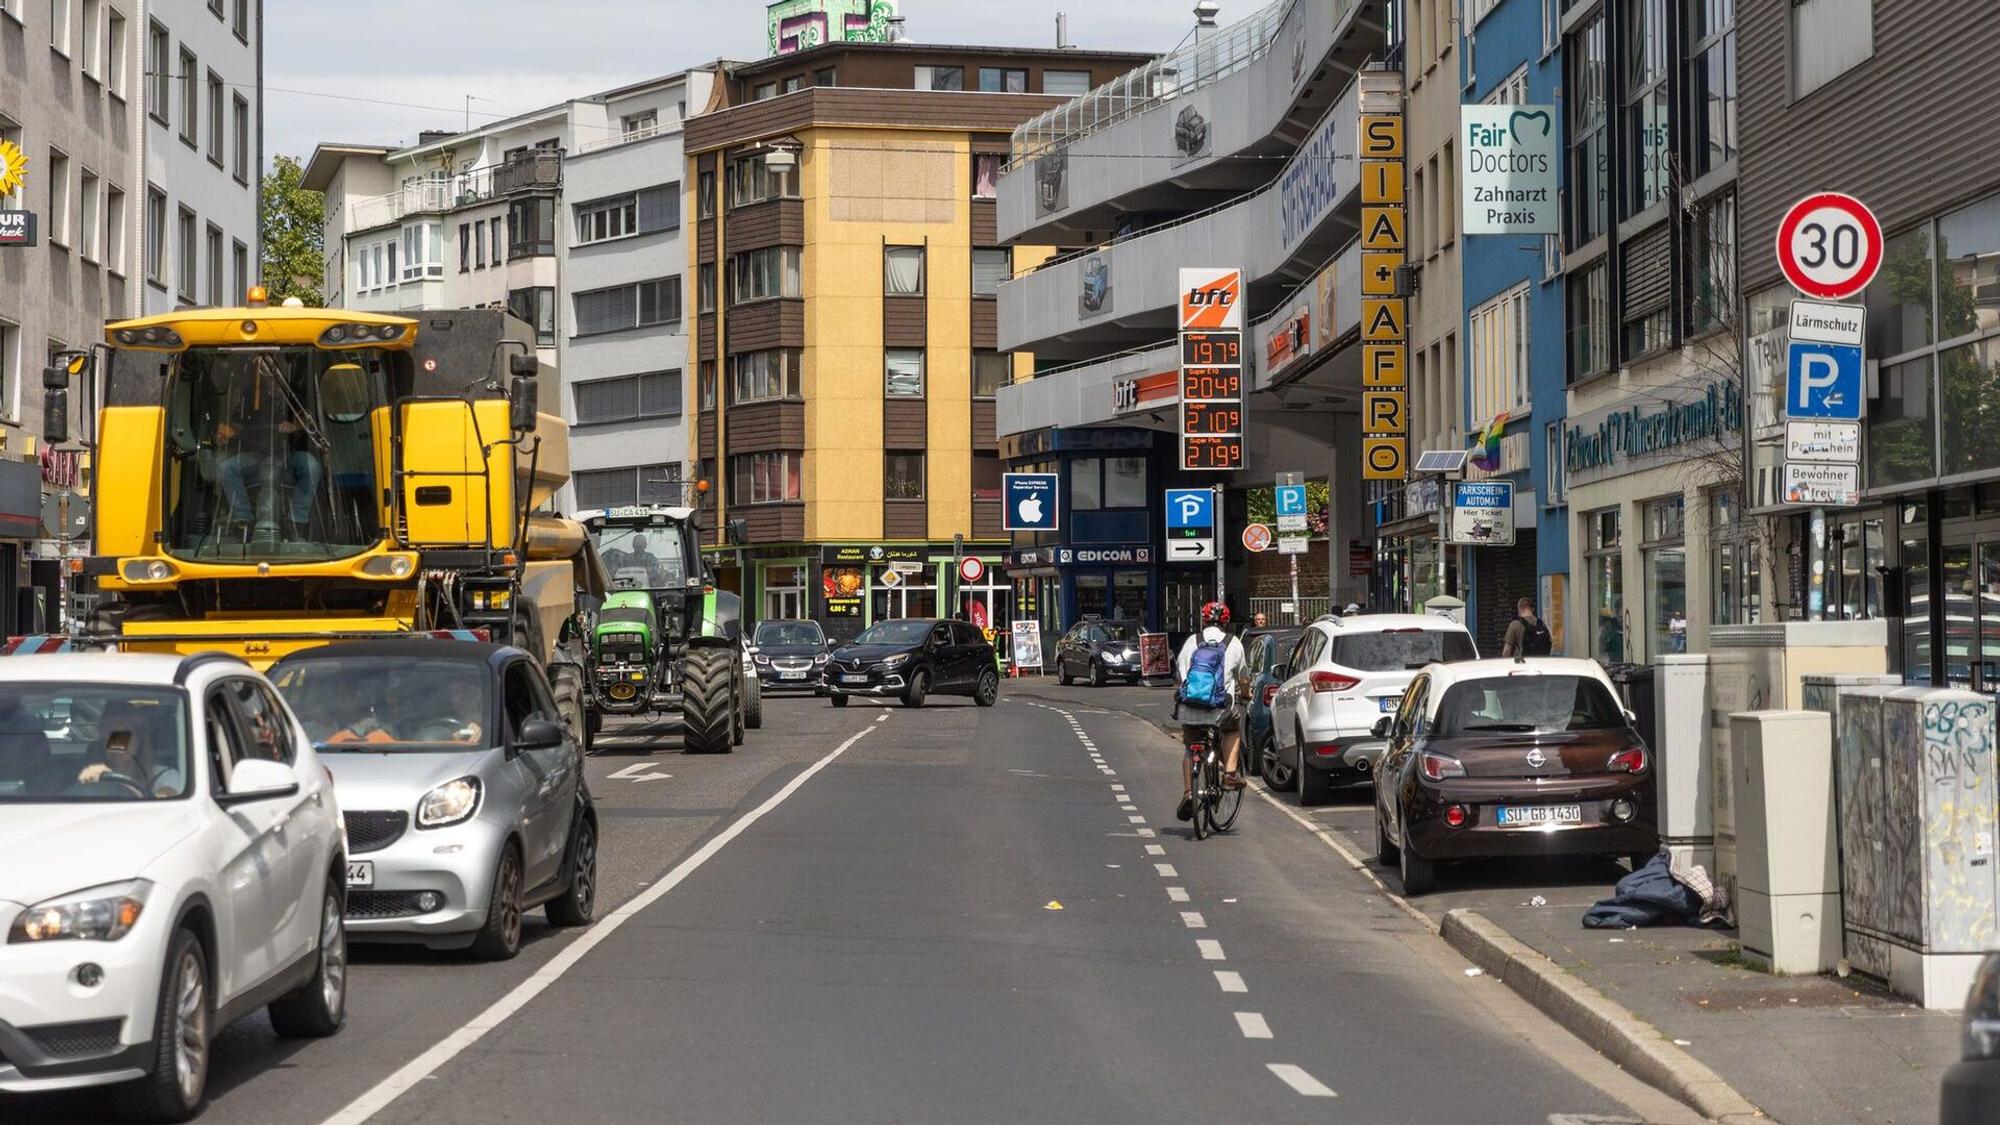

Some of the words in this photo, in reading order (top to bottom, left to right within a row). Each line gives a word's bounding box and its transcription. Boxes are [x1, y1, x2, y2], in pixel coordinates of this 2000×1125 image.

[1470, 123, 1506, 147] Fair
[1470, 148, 1548, 173] Doctors
[1474, 186, 1547, 202] Zahnarzt
[1487, 208, 1536, 224] Praxis
[1800, 222, 1859, 270] 30
[1189, 288, 1232, 307] bft
[1796, 313, 1858, 332] Lärmschutz
[1755, 336, 1787, 370] TRAV
[1189, 368, 1206, 376] Super
[1800, 353, 1839, 408] P
[1189, 403, 1207, 411] Super
[1190, 437, 1207, 445] Super
[1814, 431, 1832, 440] mit
[1792, 441, 1854, 454] Phein
[1792, 469, 1849, 480] Bewohner
[1458, 485, 1508, 496] PARKSCHEIN-
[1282, 489, 1300, 512] P
[1466, 497, 1500, 506] AUTOMAT
[1182, 501, 1200, 524] P
[1077, 550, 1132, 561] EDICOM
[1507, 808, 1522, 822] SU
[1531, 807, 1546, 821] GB
[1550, 805, 1580, 820] 1430
